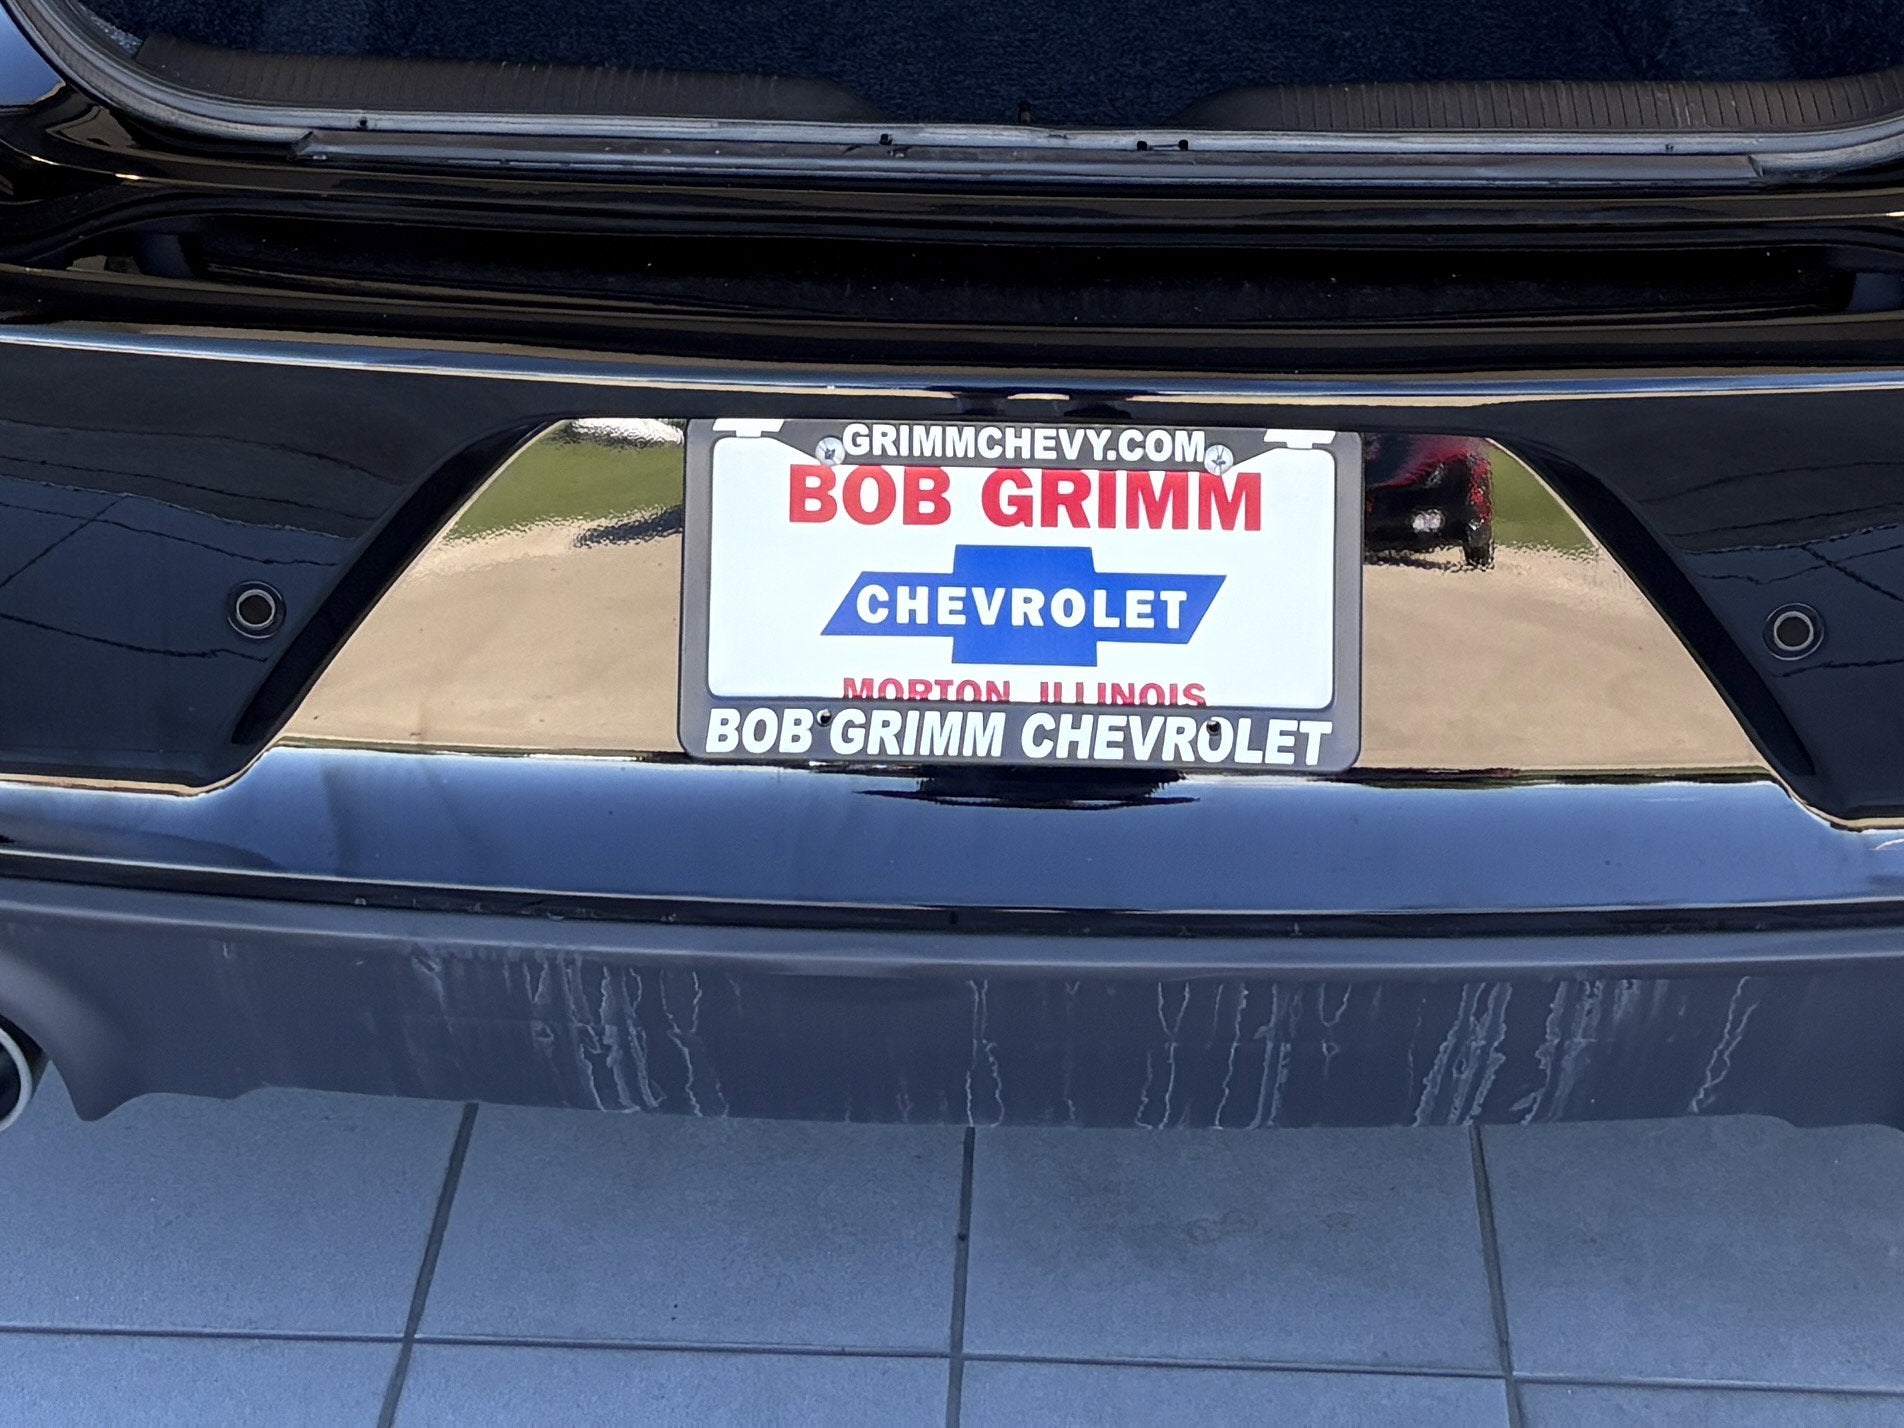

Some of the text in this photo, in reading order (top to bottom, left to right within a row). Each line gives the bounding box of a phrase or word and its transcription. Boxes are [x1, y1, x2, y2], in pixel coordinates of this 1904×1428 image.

[842, 423, 1206, 462] GRIMMCHEVY.COM
[789, 463, 1262, 532] BOB GRIMM
[855, 584, 1188, 630] CHEVROLET
[705, 707, 1334, 767] BOB GRIMM CHEVROLET
